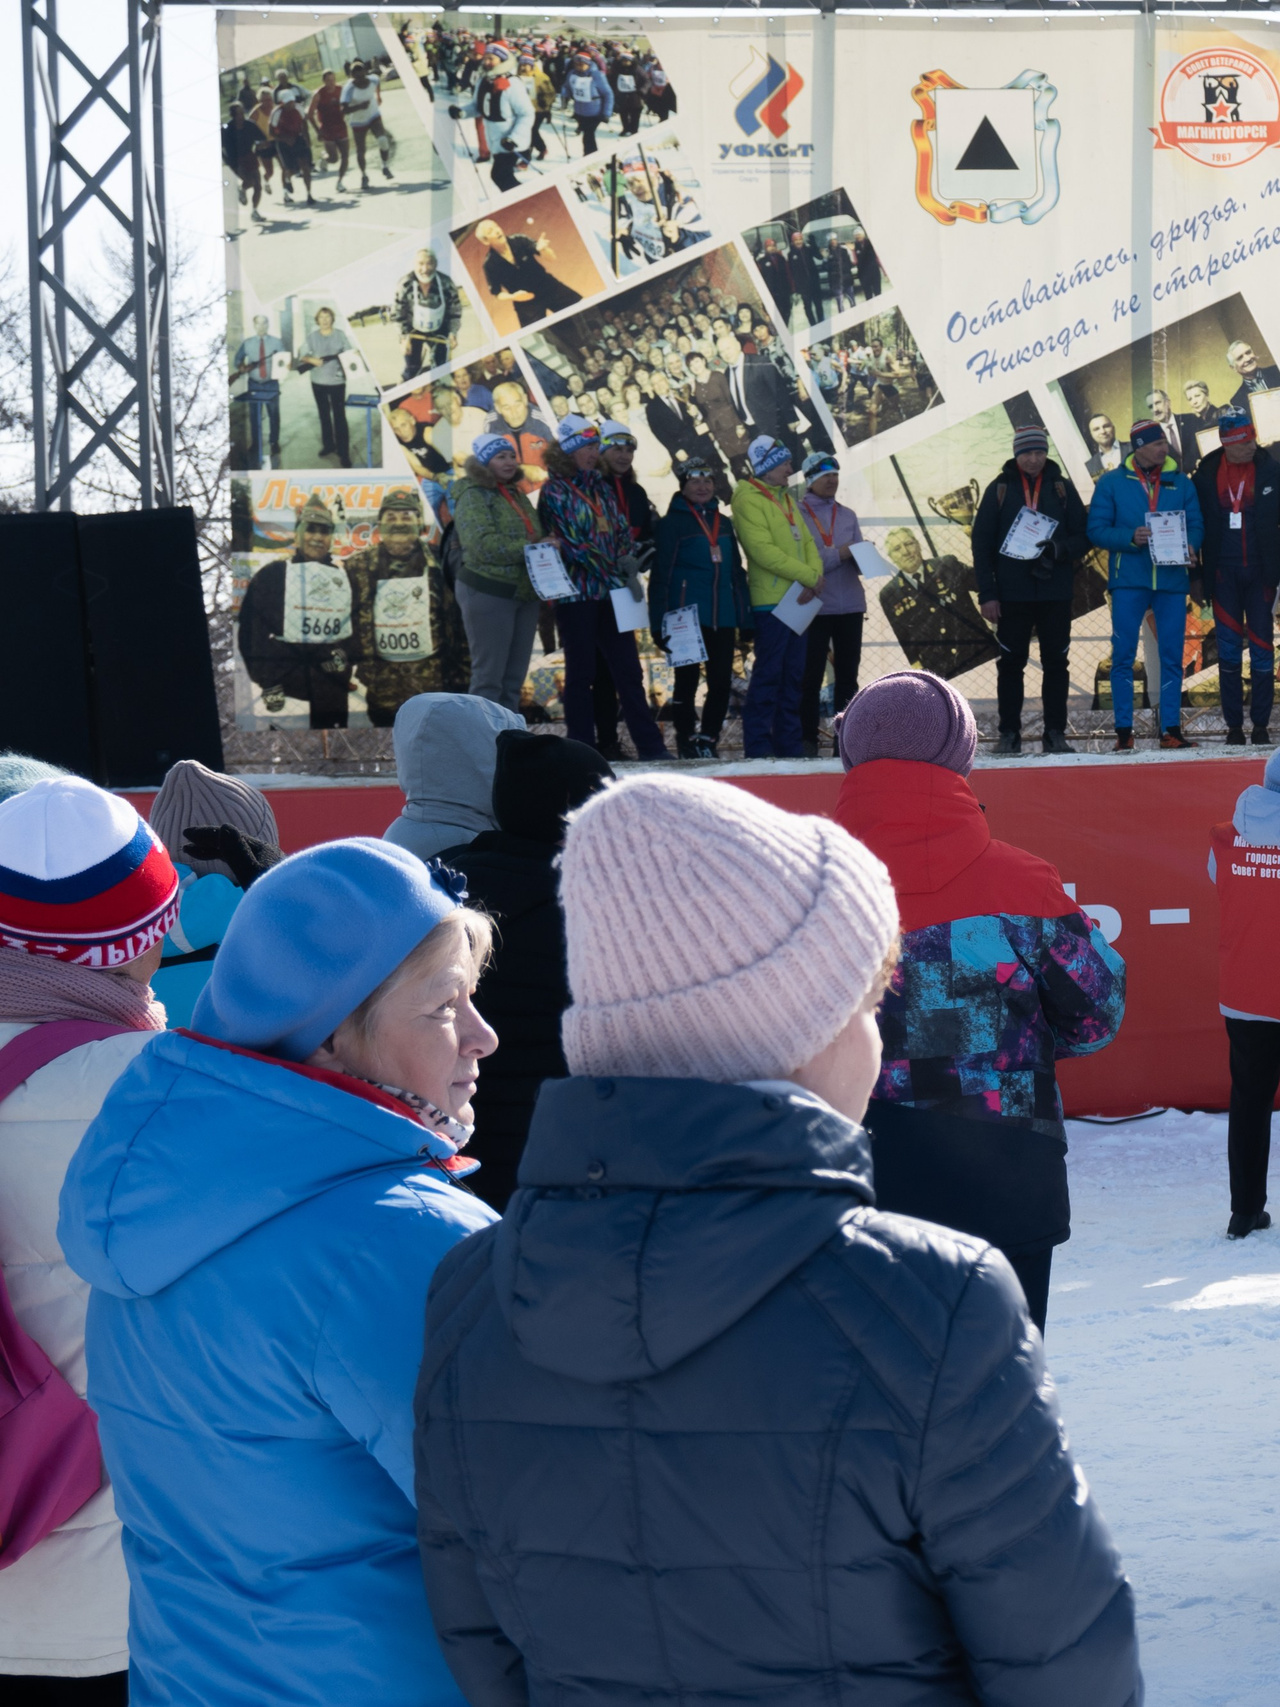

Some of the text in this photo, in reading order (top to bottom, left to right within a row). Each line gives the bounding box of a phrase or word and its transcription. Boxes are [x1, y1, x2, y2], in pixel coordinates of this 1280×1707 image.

[1185, 56, 1255, 76] СОВЕТ ВЕТЕРАНОВ
[1176, 125, 1268, 140] МАГНИТОГОРСК
[946, 248, 1138, 343] Оставайтесь,
[1149, 197, 1247, 260] друзья,
[966, 318, 1099, 384] Никогда,
[1111, 294, 1142, 322] не
[257, 478, 414, 511] Лыжн
[302, 616, 341, 635] 5668
[378, 632, 420, 650] 6008
[1231, 863, 1257, 877] Совет
[70, 902, 181, 966] ЛЫЖН
